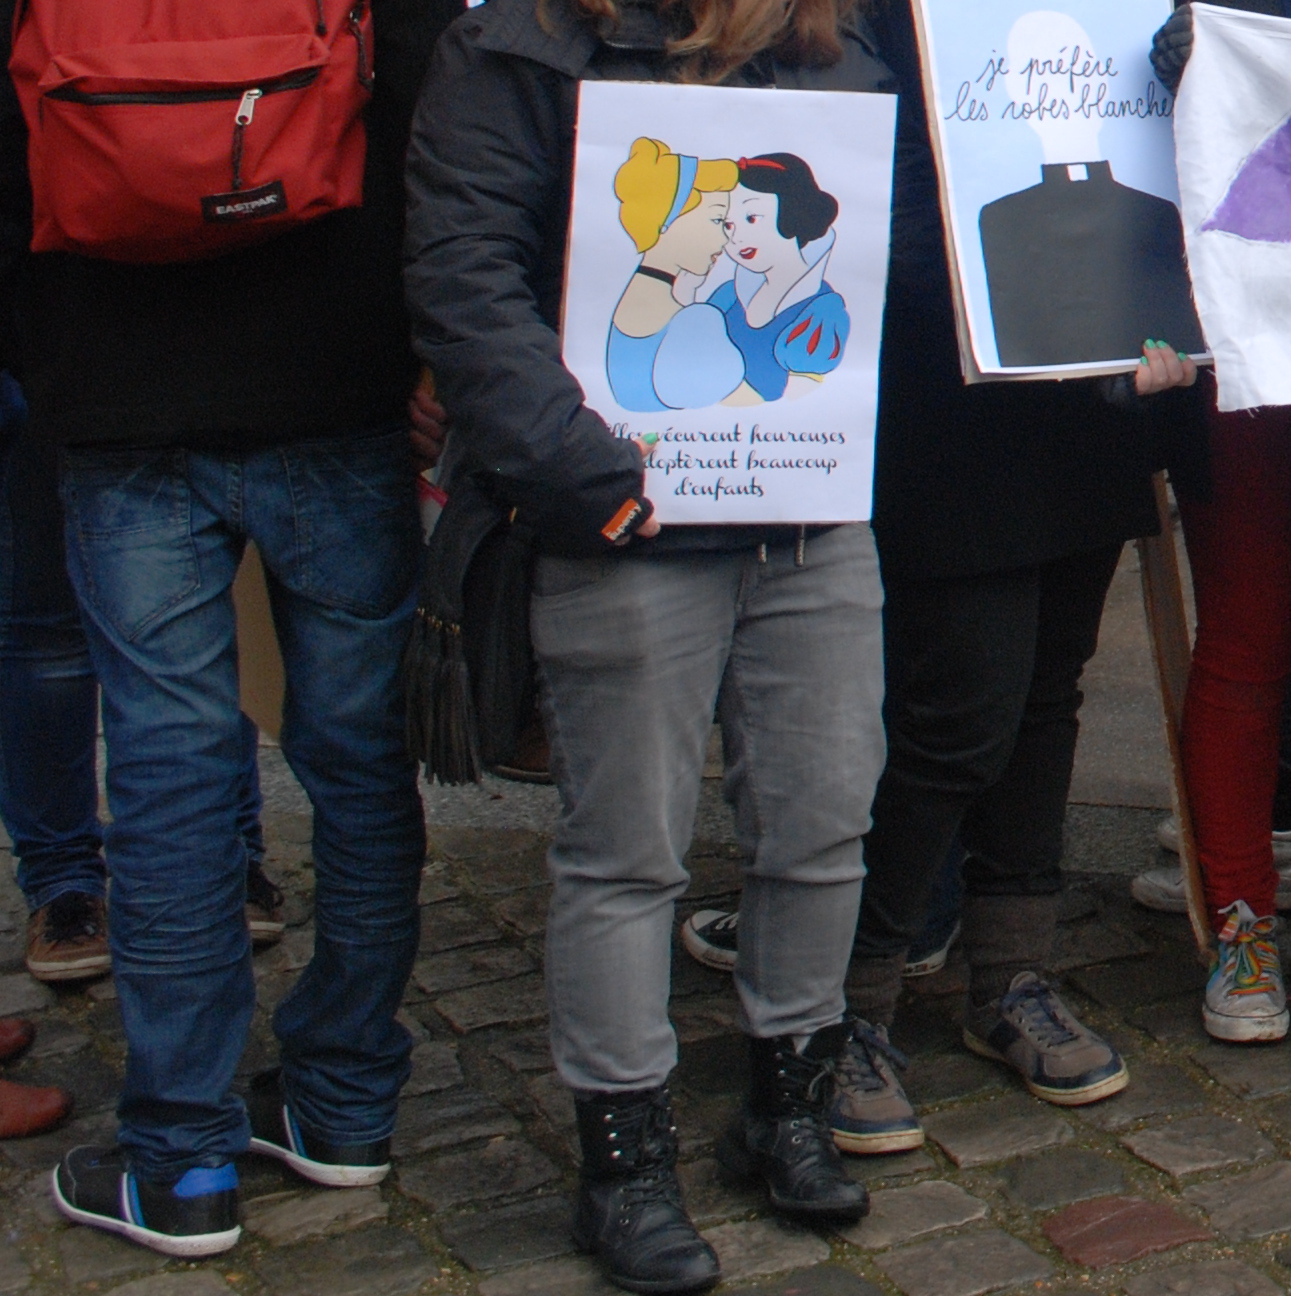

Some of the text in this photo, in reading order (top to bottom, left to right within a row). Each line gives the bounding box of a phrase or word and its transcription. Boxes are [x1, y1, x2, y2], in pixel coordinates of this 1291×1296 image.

[976, 45, 1119, 95] je préfère
[944, 80, 1174, 122] les robes blanche
[215, 194, 278, 215] EASTPAK
[750, 423, 846, 445] heureuses
[643, 449, 838, 476] doptèrent beaucoup
[674, 476, 765, 501] d'enfants
